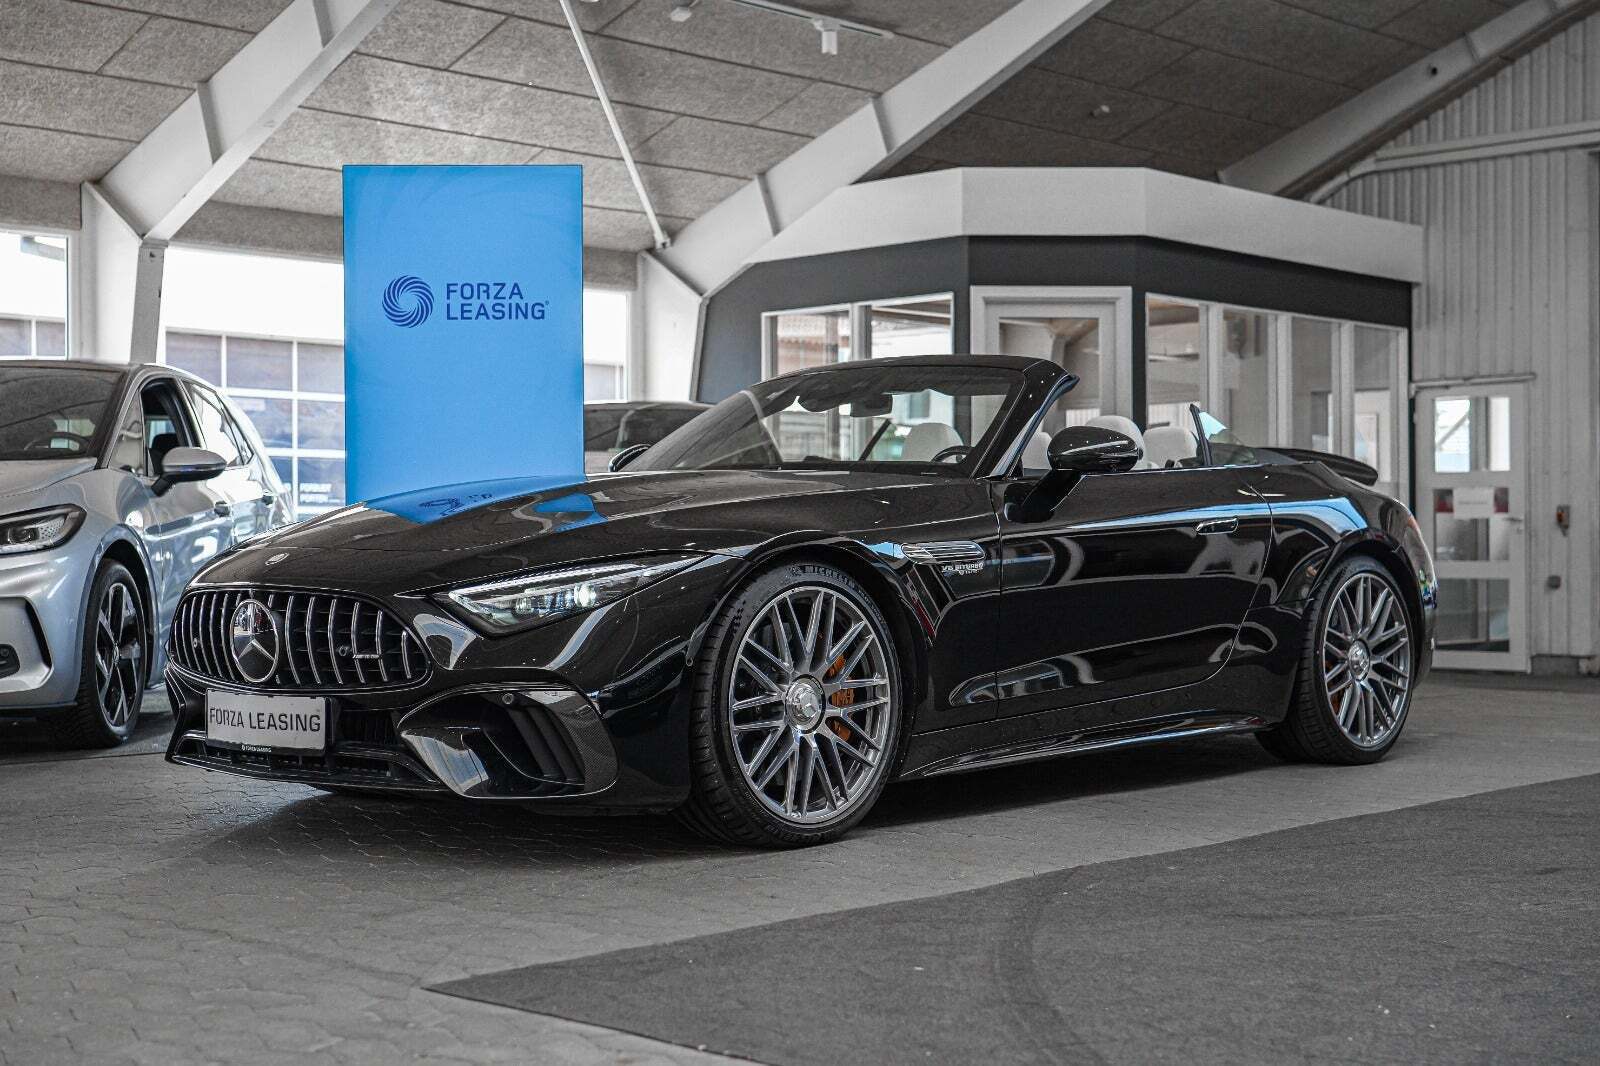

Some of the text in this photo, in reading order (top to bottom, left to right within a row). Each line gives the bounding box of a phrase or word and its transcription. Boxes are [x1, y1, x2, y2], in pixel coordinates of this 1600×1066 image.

[446, 282, 524, 300] FORZA
[209, 707, 321, 732] FORZA LEASING
